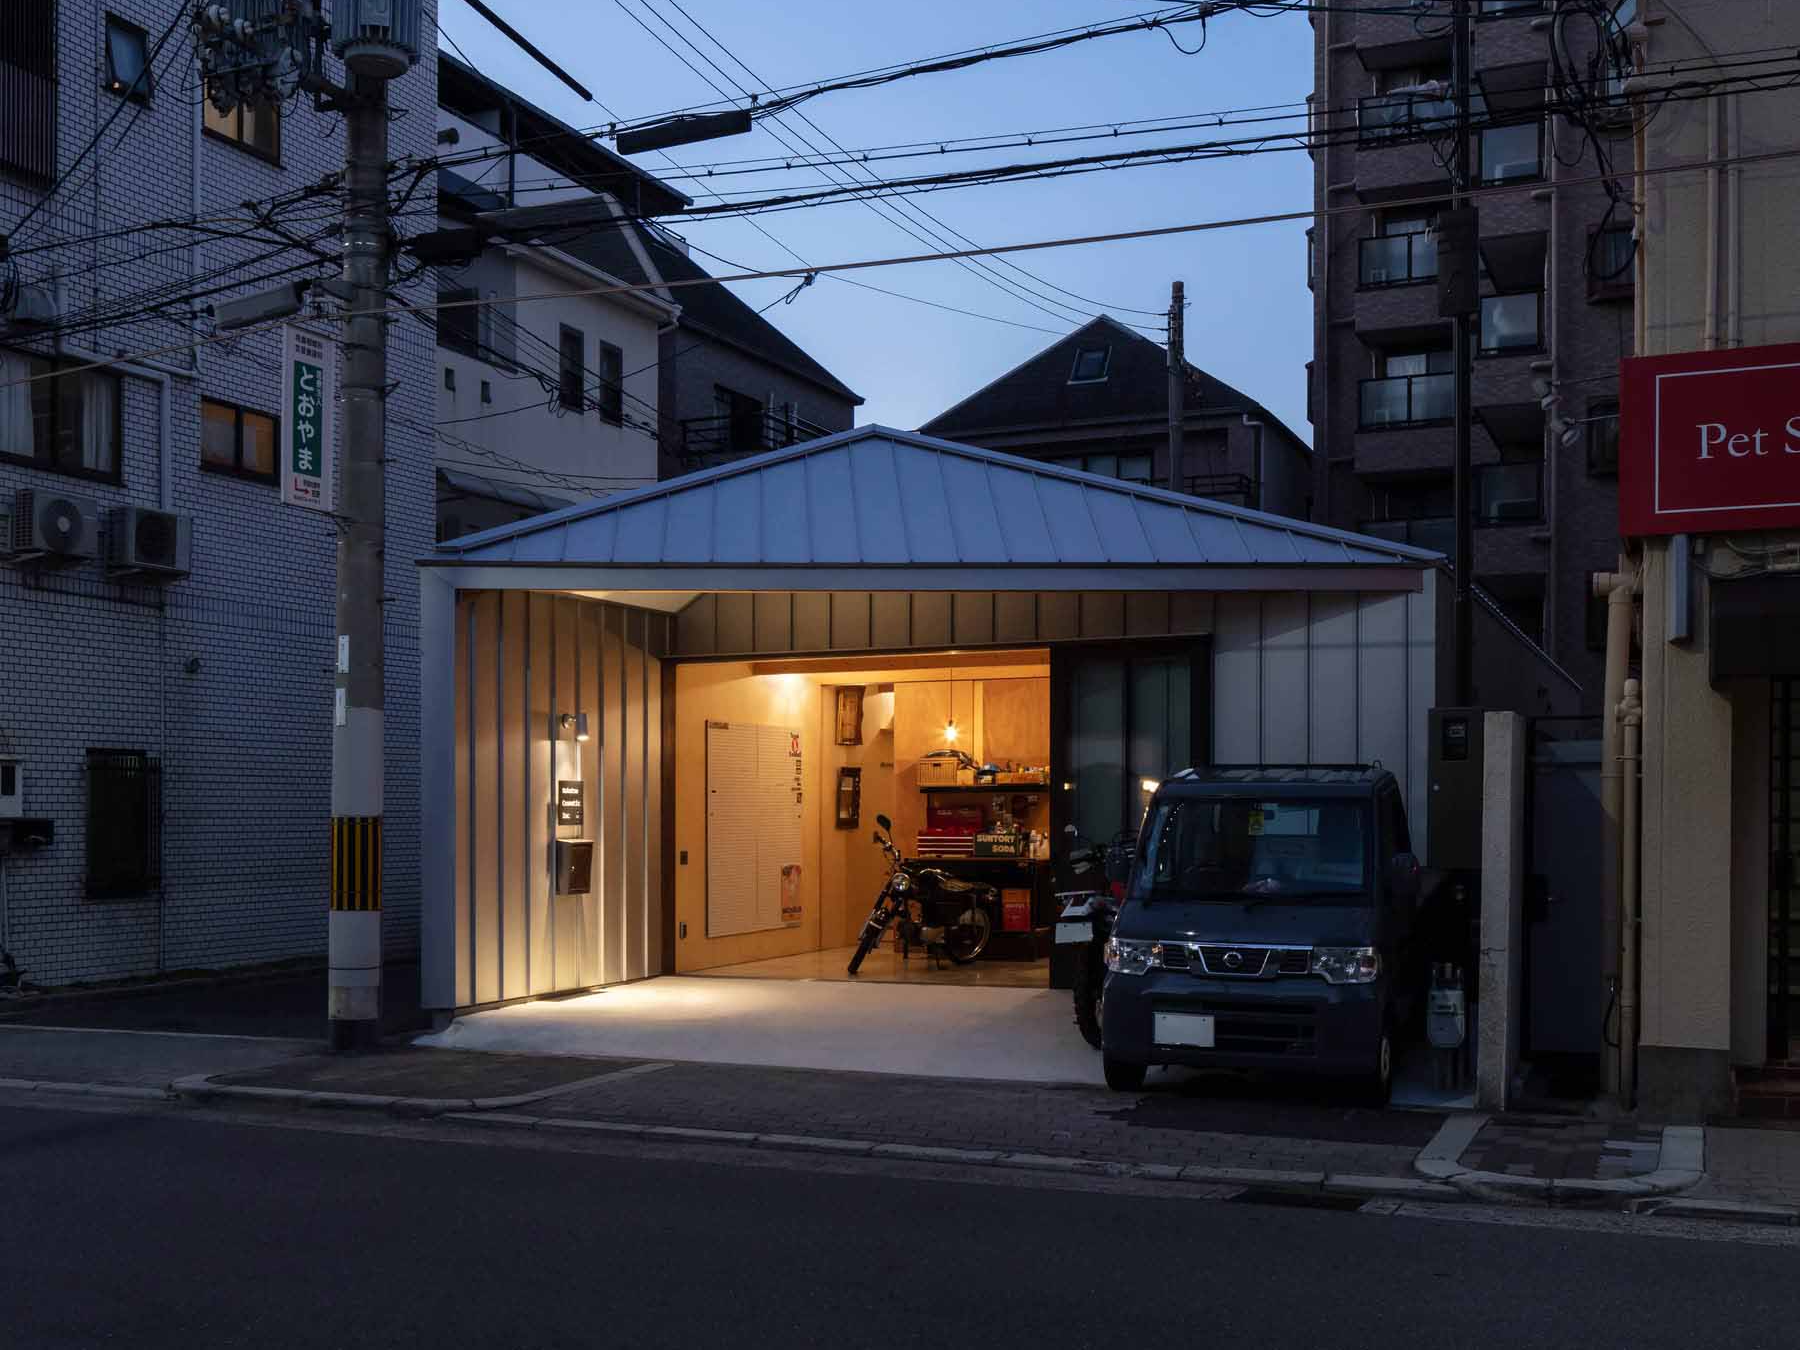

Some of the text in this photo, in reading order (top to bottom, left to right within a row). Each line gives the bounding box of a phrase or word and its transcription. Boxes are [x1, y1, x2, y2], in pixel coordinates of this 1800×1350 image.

[297, 364, 316, 471] とおやま
[1695, 422, 1769, 460] Pet
[991, 844, 1016, 854] SODA
